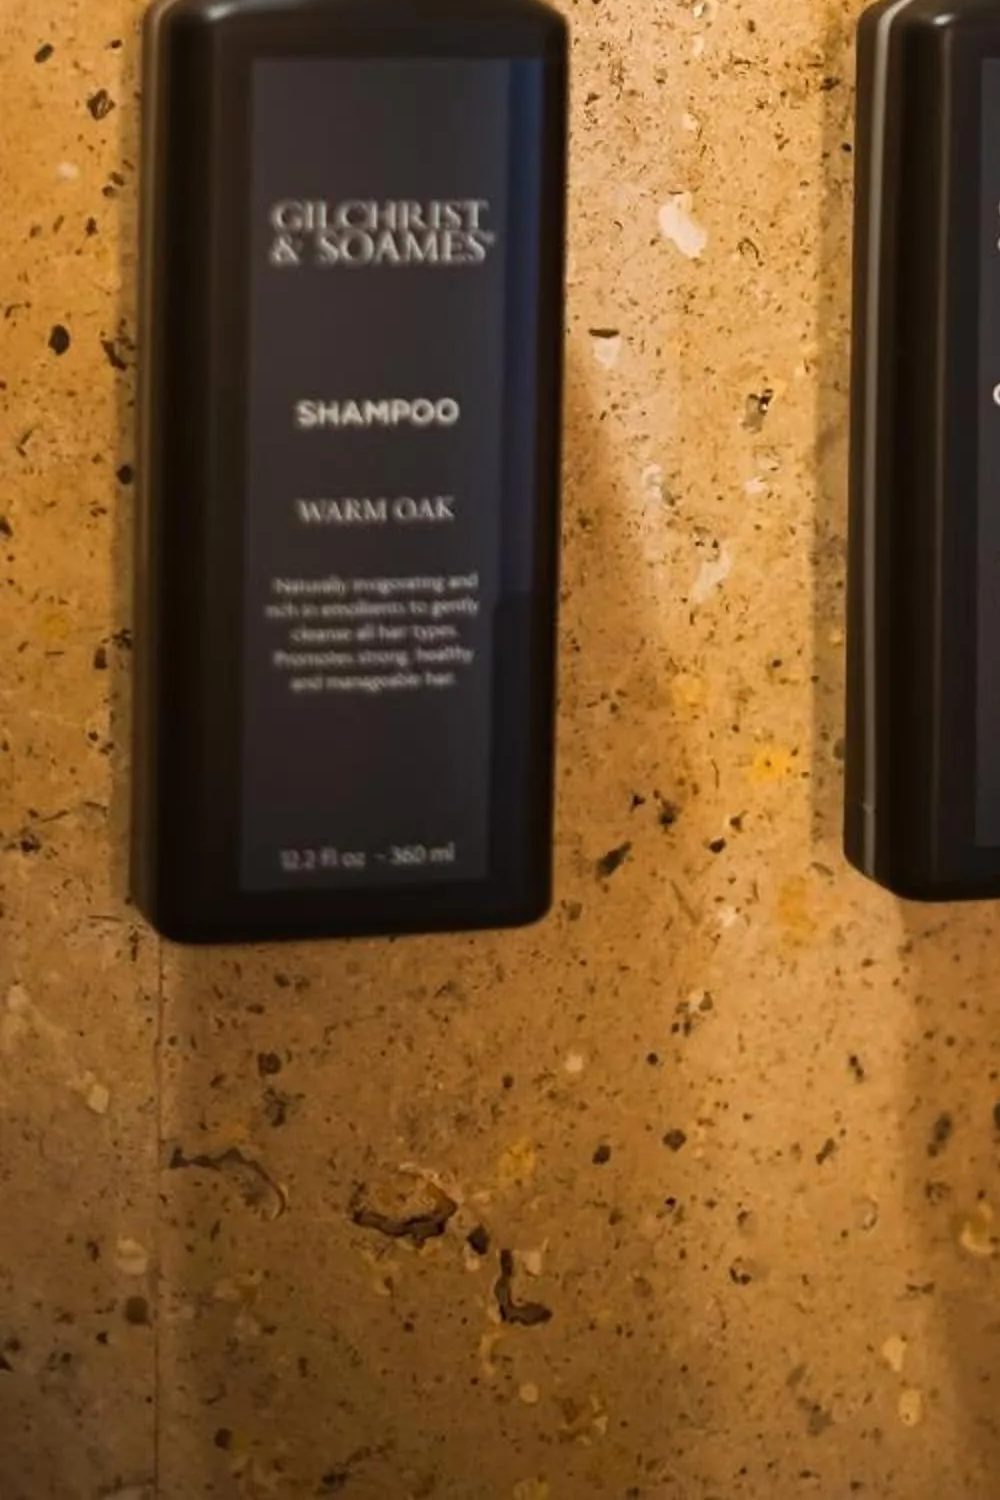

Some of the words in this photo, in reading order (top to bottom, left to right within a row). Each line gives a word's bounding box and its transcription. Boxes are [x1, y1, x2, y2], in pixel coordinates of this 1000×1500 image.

[270, 199, 490, 229] GILCHRIST
[269, 234, 300, 266] &
[296, 398, 460, 428] SHAMPOO
[297, 498, 387, 523] WARM
[393, 496, 455, 522] OAK
[448, 572, 479, 590] and
[290, 675, 323, 692] and
[429, 841, 456, 863] ml
